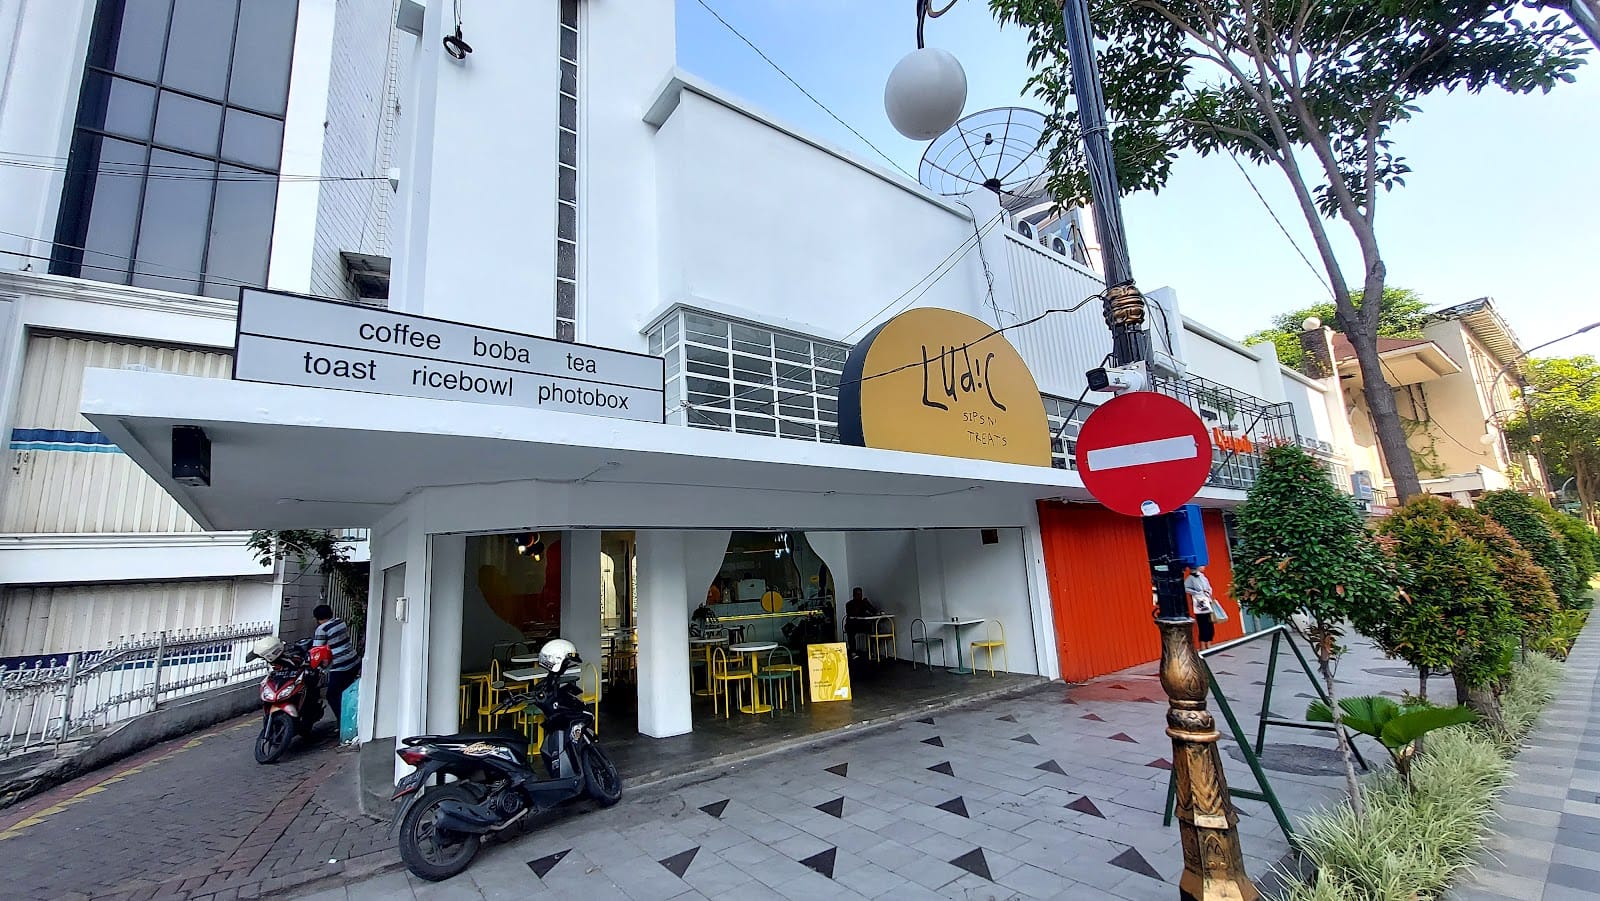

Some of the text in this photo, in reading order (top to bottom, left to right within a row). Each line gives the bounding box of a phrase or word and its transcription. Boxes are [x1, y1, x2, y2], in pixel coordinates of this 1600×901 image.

[359, 323, 597, 374] coffee boba tea
[303, 351, 629, 410] toast ricebowl photobox
[962, 411, 985, 425] SIPS
[967, 430, 1008, 447] TREATS
